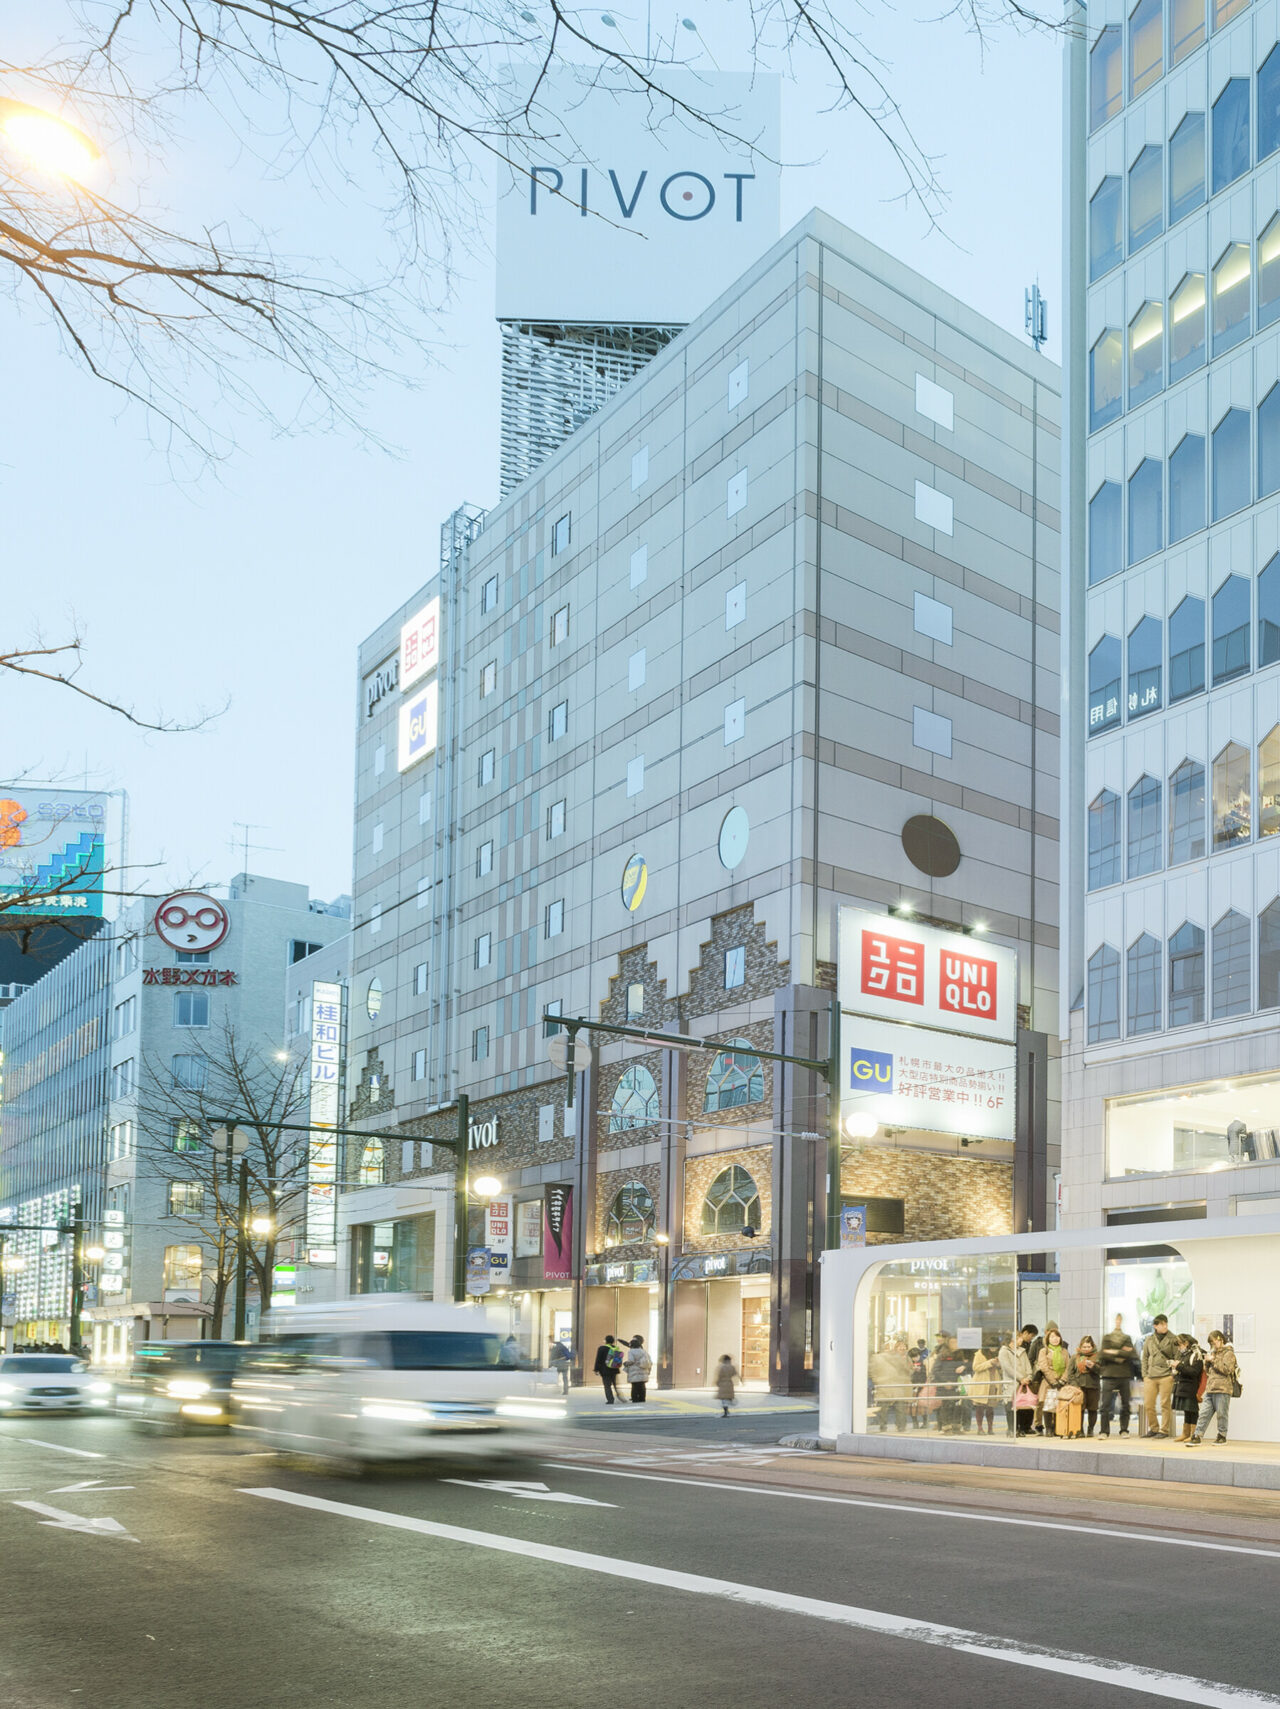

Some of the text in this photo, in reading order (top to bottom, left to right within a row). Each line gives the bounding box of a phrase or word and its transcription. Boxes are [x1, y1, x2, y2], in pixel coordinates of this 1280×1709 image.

[530, 166, 756, 222] PIVOT
[409, 710, 428, 742] GU
[142, 967, 239, 986] 水野メガネ
[314, 1003, 338, 1080] 桂和ビル
[853, 1060, 892, 1083] GU
[986, 1096, 1005, 1109] 6F
[490, 1256, 507, 1265] GU
[705, 1257, 726, 1274] pivot
[607, 1264, 624, 1281] pivot
